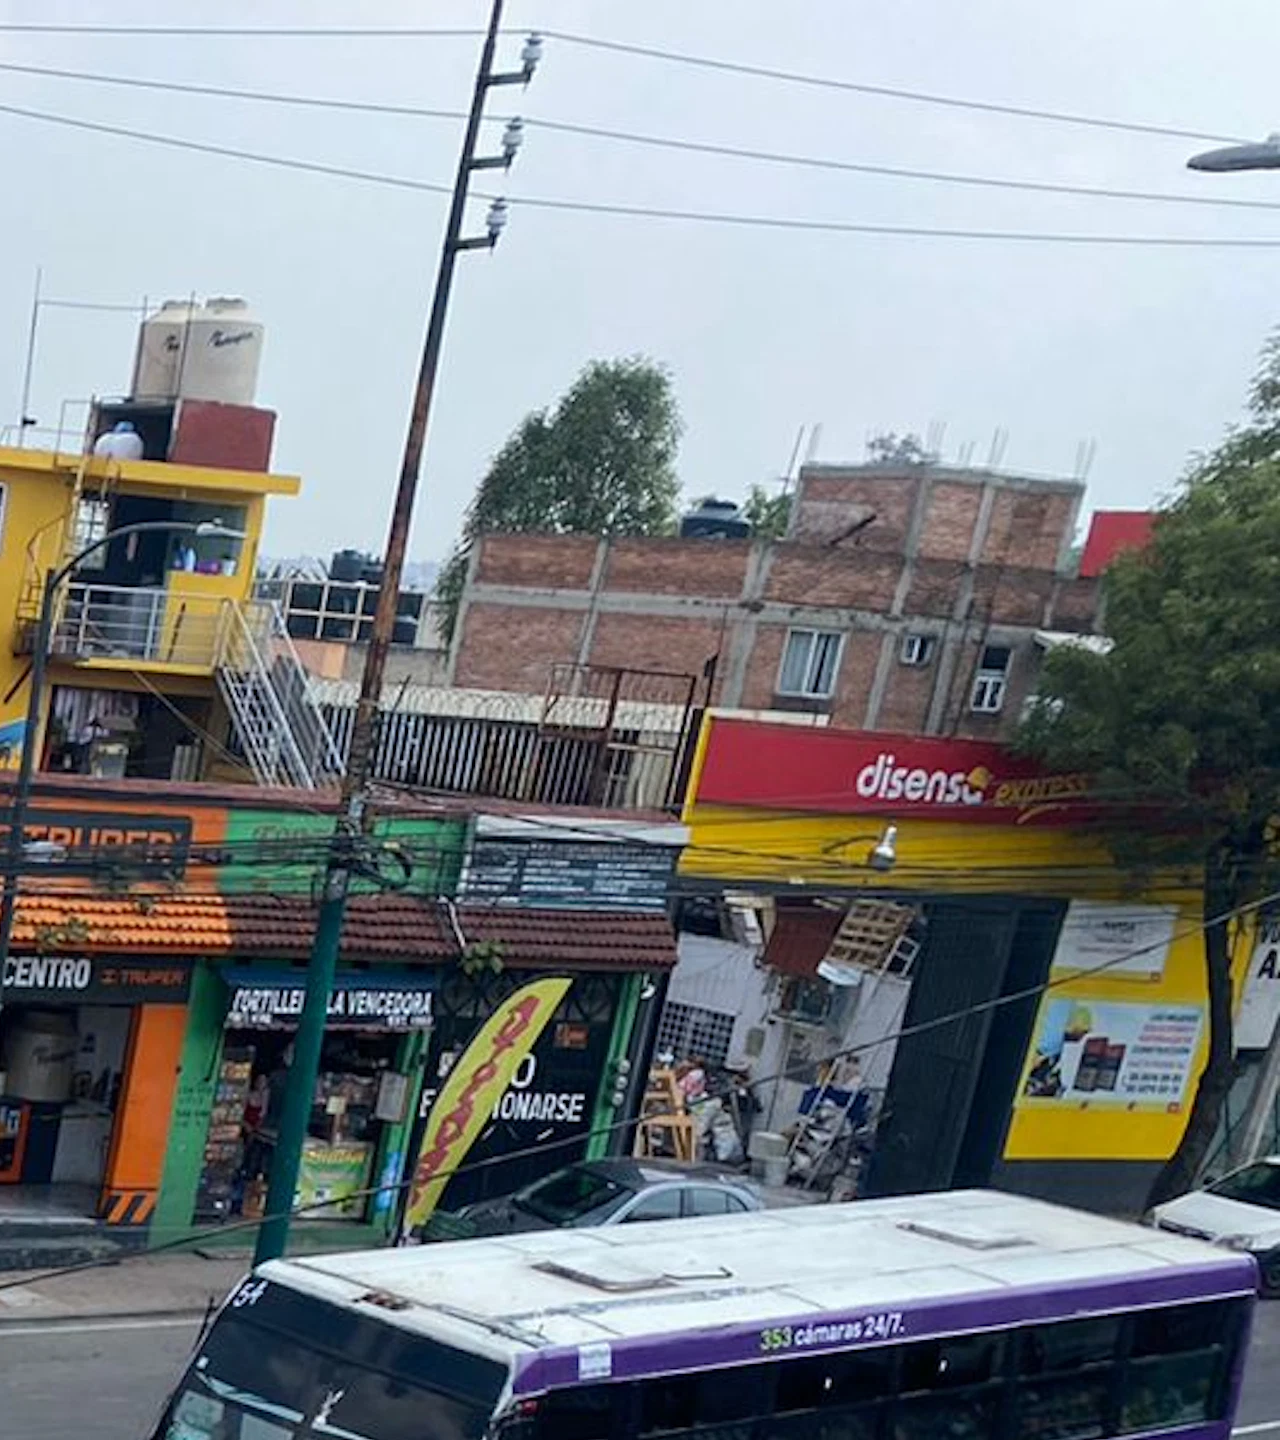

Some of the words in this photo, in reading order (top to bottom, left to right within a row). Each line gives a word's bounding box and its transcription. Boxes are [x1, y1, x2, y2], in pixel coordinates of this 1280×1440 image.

[326, 989, 344, 1015] LA
[347, 990, 433, 1016] VENCEDORA
[231, 1279, 268, 1308] 54
[759, 1327, 794, 1352] 353
[796, 1321, 863, 1347] cámaras
